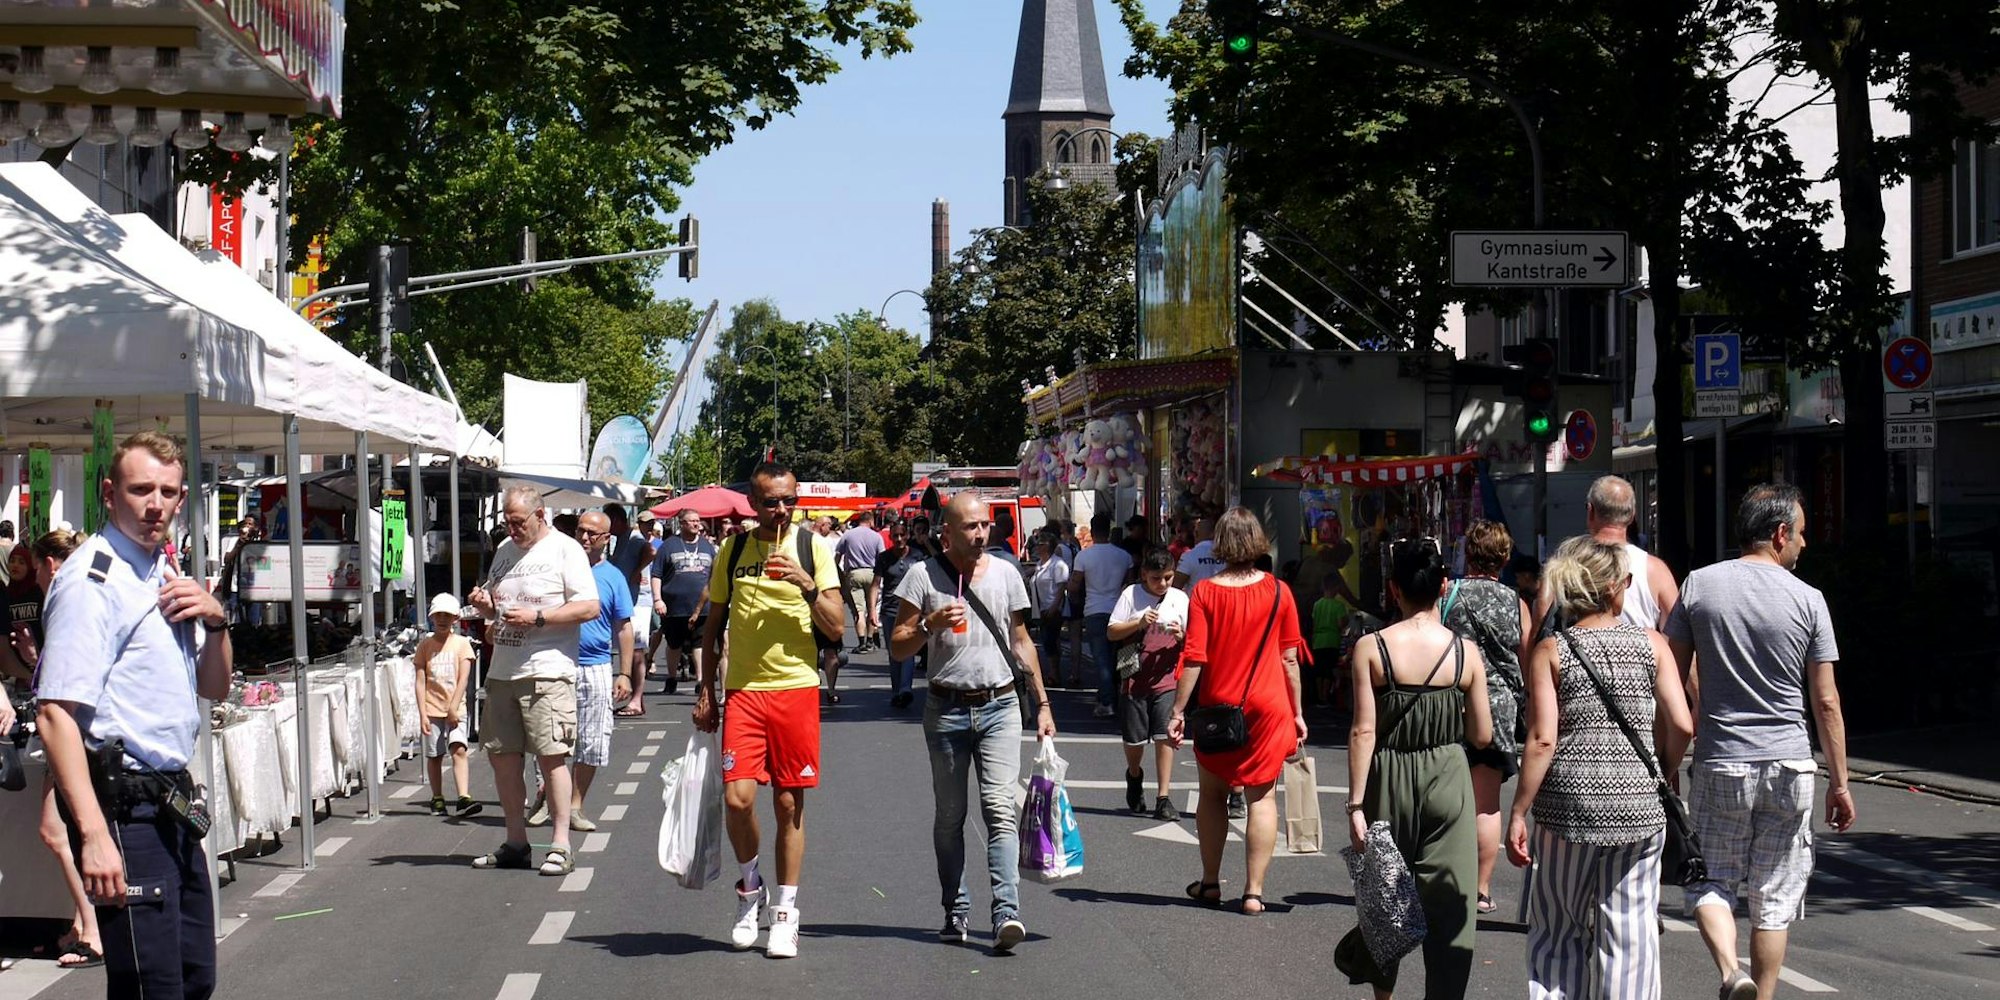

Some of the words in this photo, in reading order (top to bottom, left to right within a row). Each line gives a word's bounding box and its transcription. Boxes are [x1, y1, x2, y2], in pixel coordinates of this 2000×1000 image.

[1481, 239, 1587, 259] Gymnasium
[1487, 262, 1587, 279] Kantstraße
[1704, 341, 1729, 381] P
[810, 484, 831, 495] früh
[385, 505, 404, 522] jetzt
[386, 528, 403, 574] 5.99
[735, 561, 763, 579] adi
[10, 605, 38, 620] YWAY
[126, 886, 143, 896] IZEI
